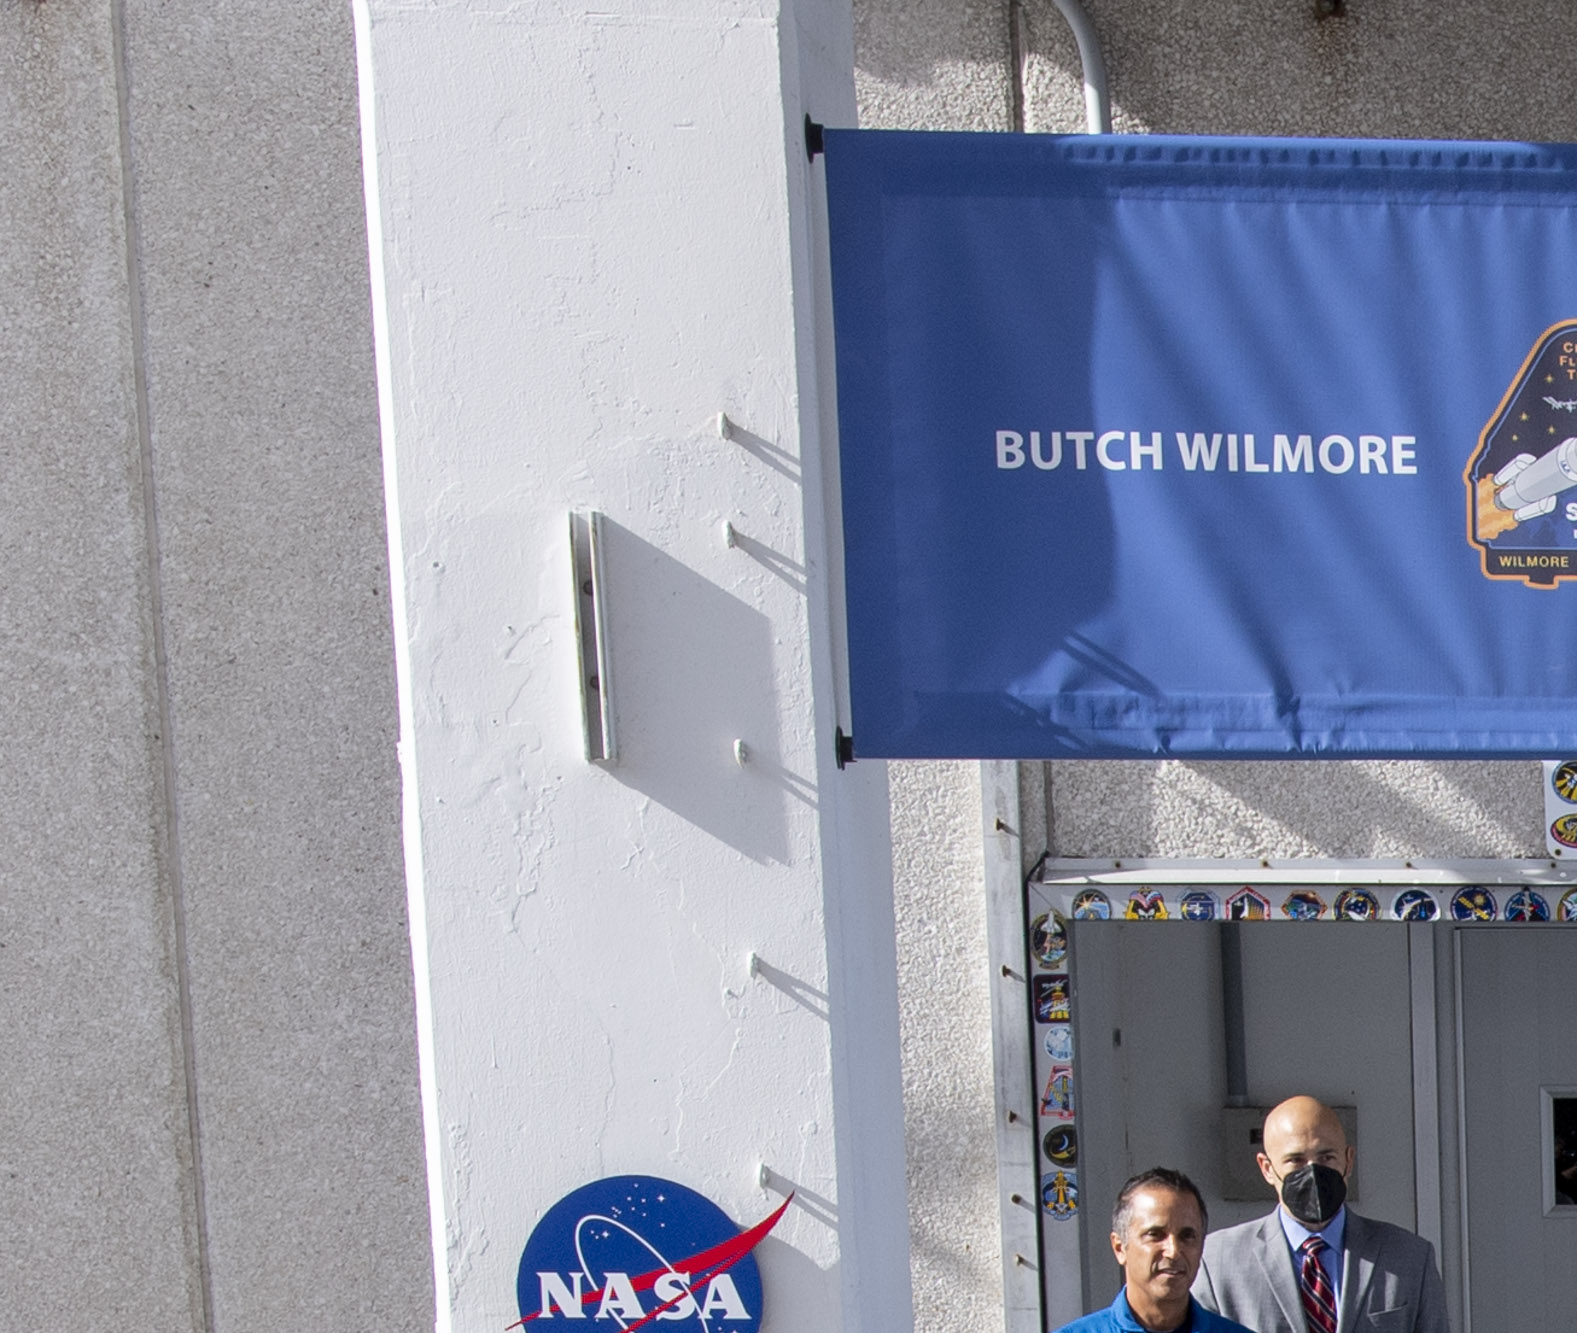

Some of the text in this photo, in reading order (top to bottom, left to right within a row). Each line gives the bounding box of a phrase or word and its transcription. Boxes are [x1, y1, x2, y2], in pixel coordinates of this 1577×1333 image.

[995, 430, 1419, 475] BUTCH WILMORE
[1500, 555, 1569, 569] WILMORE
[536, 1270, 752, 1321] NASA
